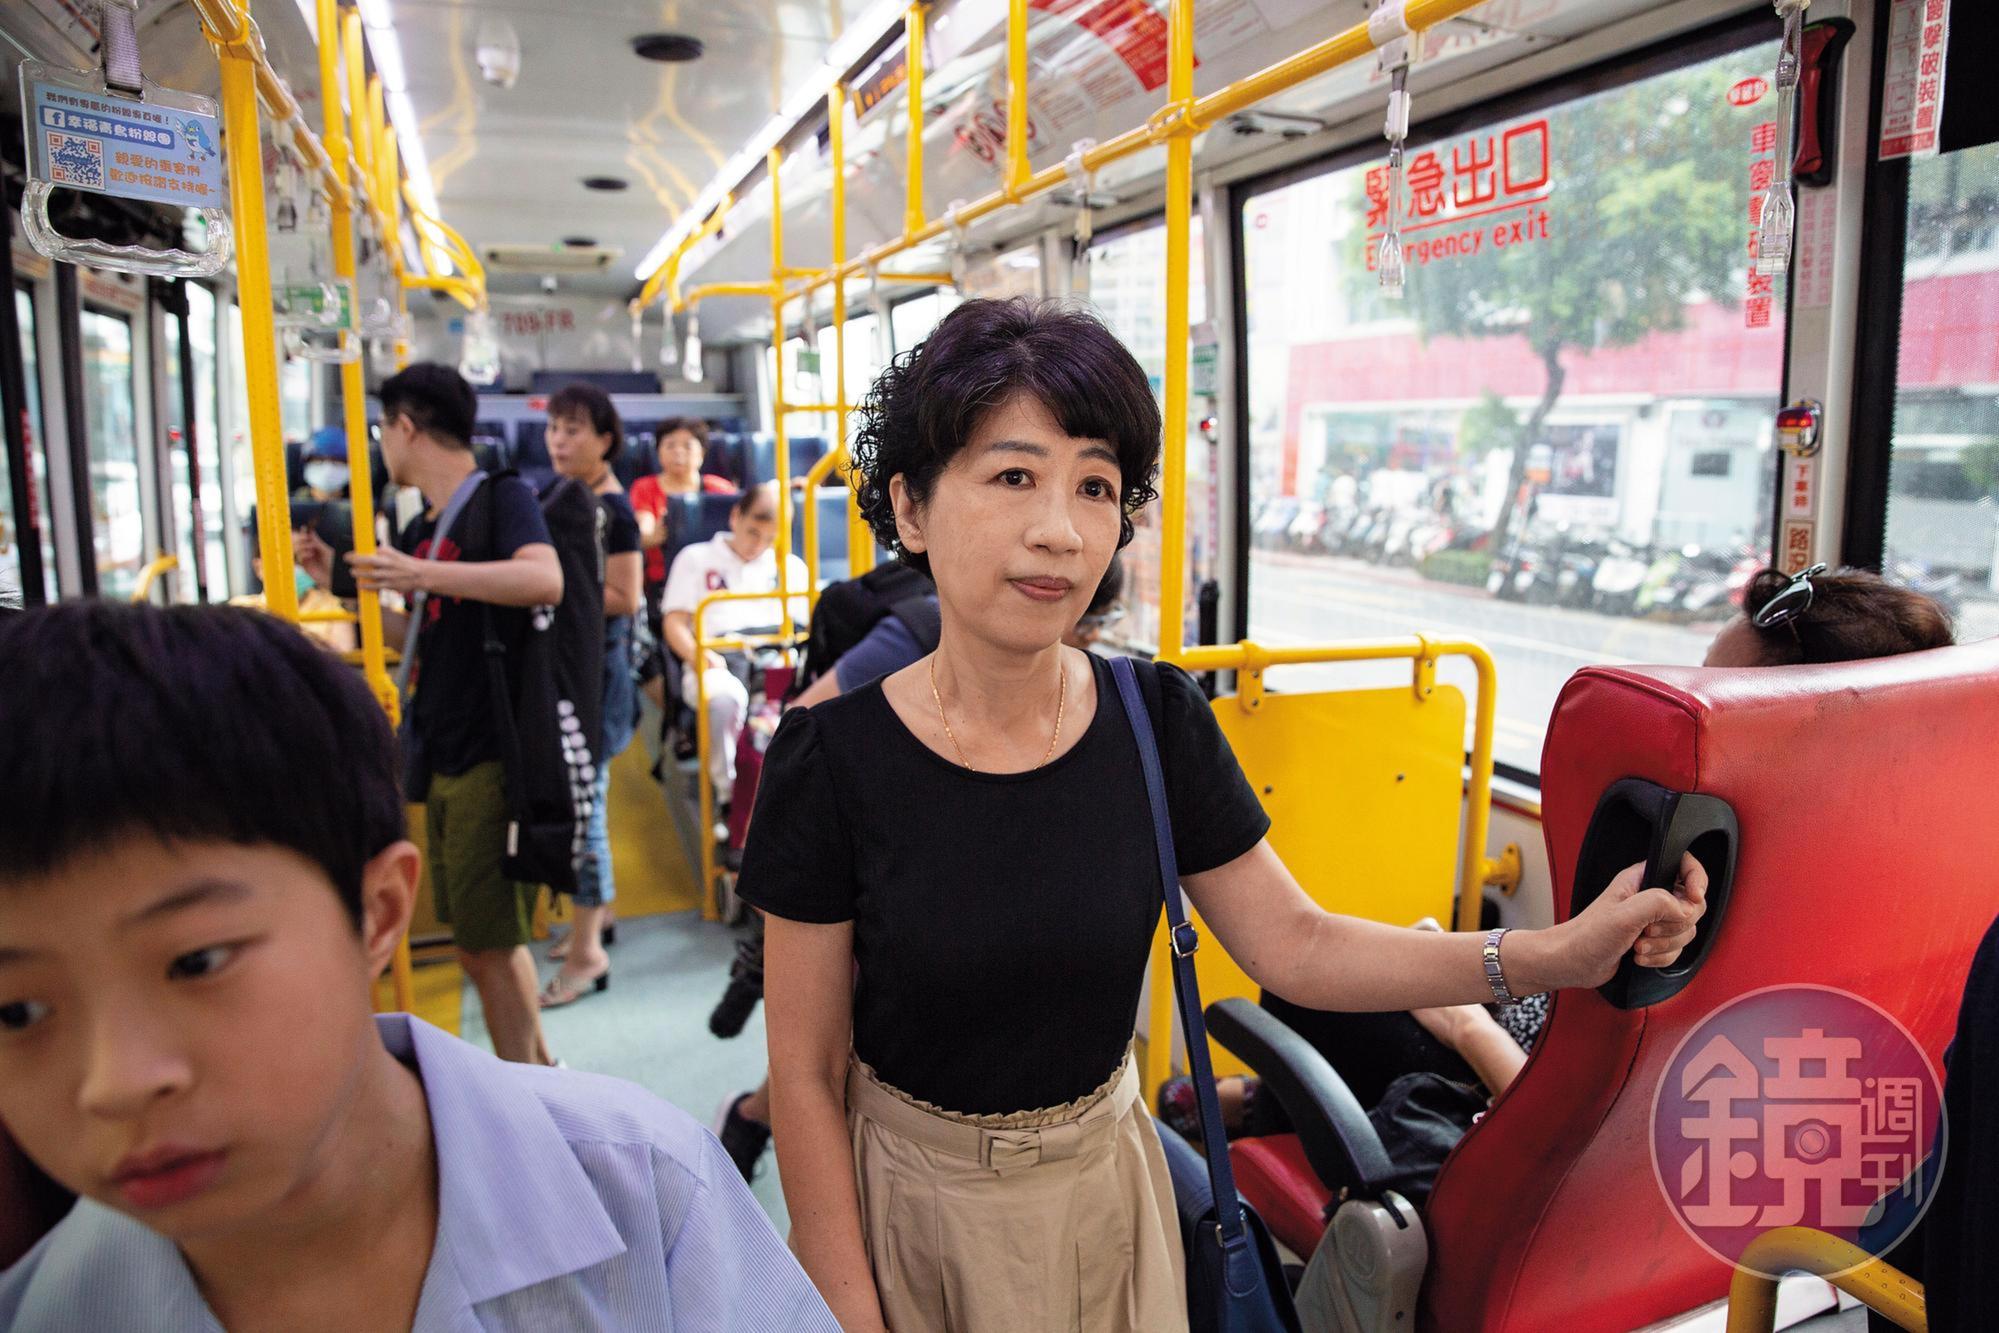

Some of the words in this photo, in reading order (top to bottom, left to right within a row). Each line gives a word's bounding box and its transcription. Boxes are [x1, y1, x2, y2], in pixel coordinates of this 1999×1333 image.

[1366, 120, 1548, 228] 緊急出口
[1366, 229, 1484, 272] Ergency
[1493, 208, 1550, 247] exit
